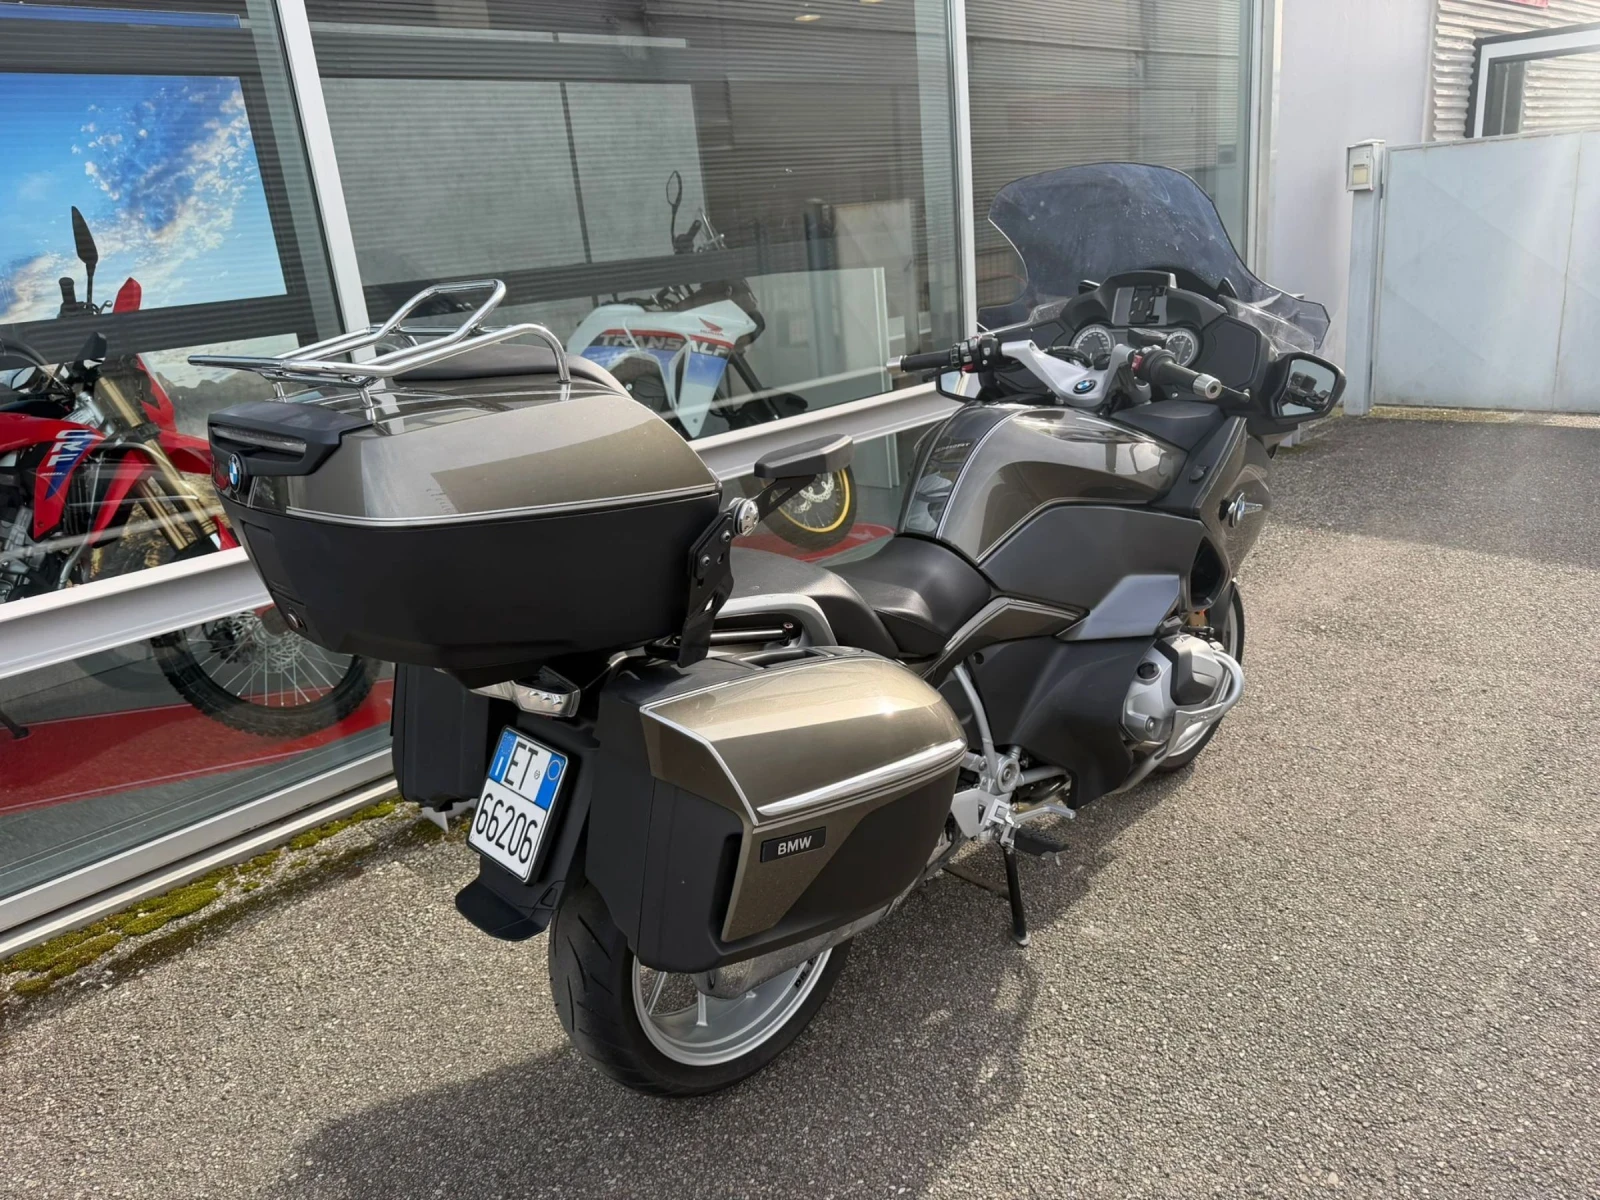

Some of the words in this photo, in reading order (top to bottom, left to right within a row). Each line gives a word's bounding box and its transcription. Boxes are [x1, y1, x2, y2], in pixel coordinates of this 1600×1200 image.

[600, 334, 730, 356] TRANSALP
[46, 429, 106, 467] CRF
[503, 741, 538, 790] ET
[475, 792, 538, 864] 66206
[777, 835, 812, 856] BMW
